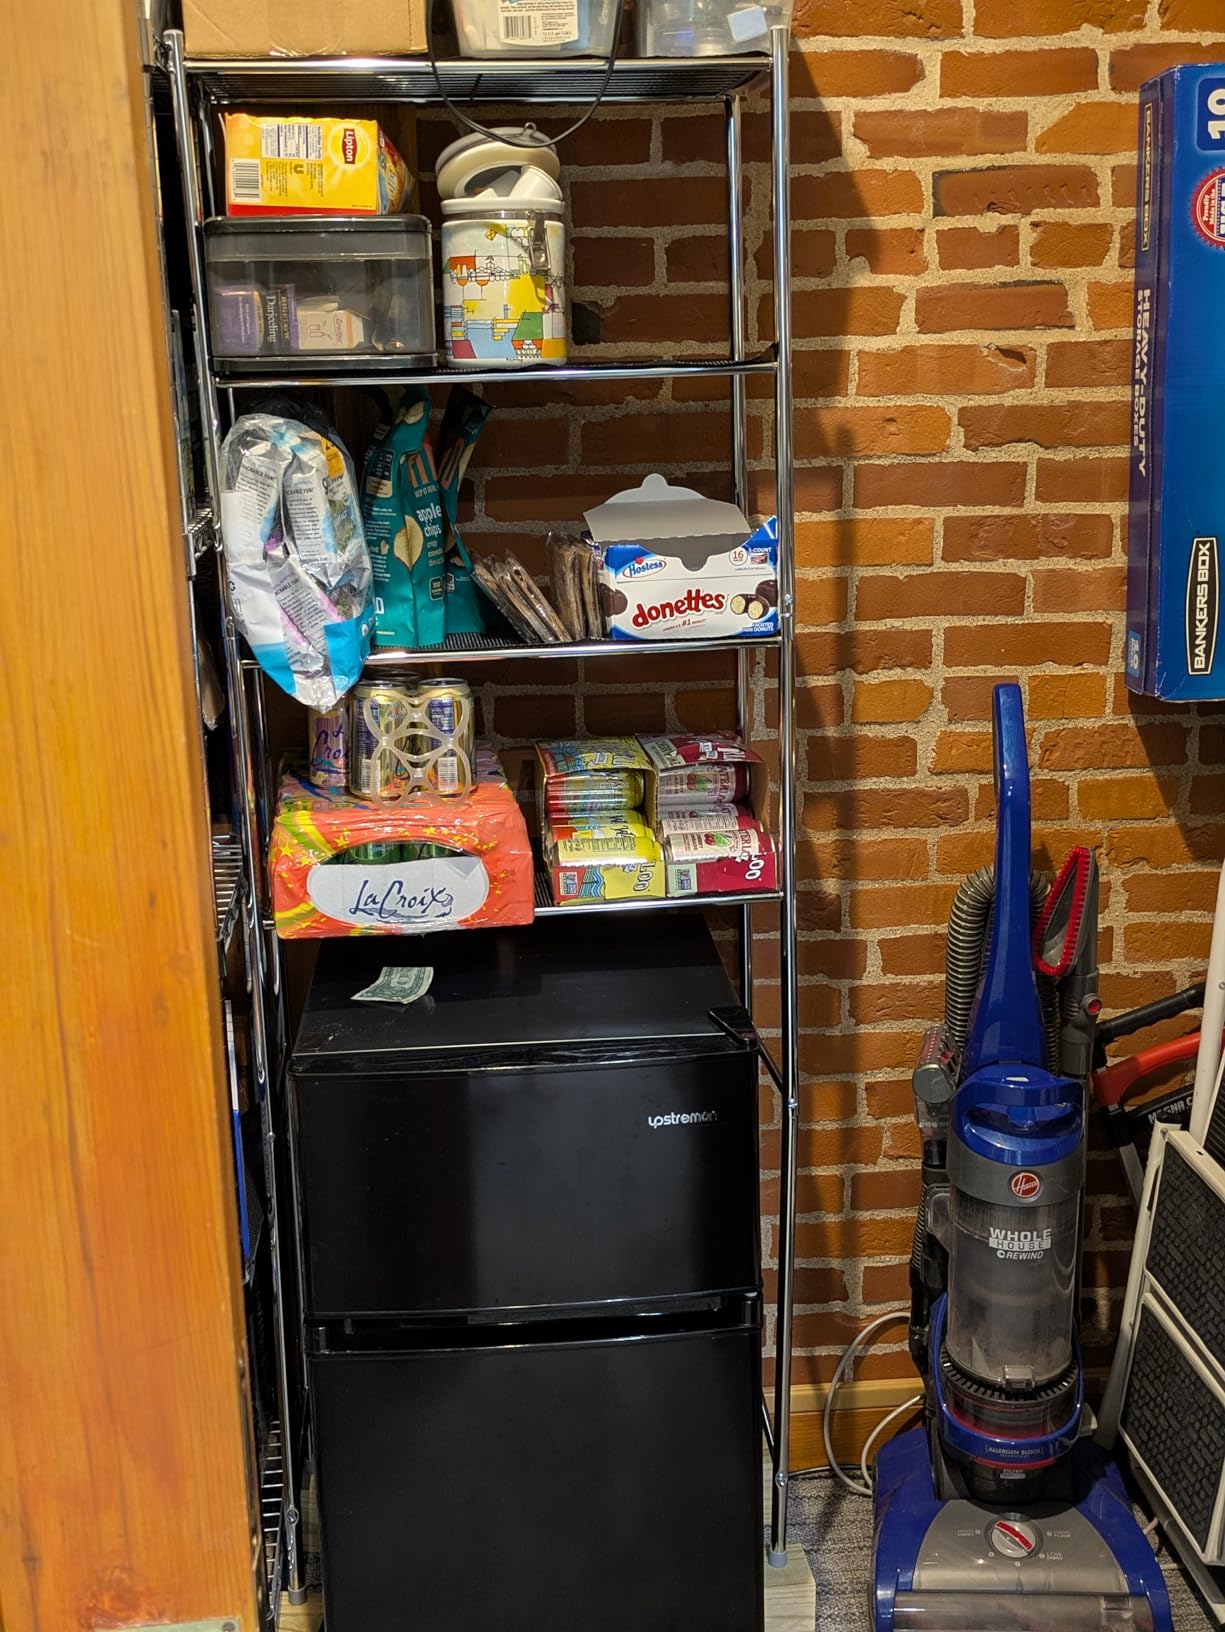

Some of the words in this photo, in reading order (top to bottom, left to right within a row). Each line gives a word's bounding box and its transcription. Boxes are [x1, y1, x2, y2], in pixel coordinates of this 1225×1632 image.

[345, 130, 354, 162] Lipton
[1202, 194, 1210, 221] Proudly
[265, 295, 278, 344] Darjeeling
[280, 296, 289, 341] BIGELOW
[1134, 290, 1143, 381] STORAGE
[1138, 289, 1151, 477] HEAVY-DUTY
[416, 502, 442, 523] apple
[424, 523, 442, 537] chips
[628, 560, 664, 577] Hostess
[1197, 542, 1211, 582] BOX
[632, 588, 726, 628] donettes
[682, 618, 691, 626] #1
[1194, 584, 1208, 669] BANKERS
[349, 880, 450, 919] LaCroix
[989, 1227, 1052, 1242] WHOLE
[996, 1241, 1045, 1250] HOUSE
[1006, 1251, 1044, 1260] REWIND
[988, 1447, 1019, 1455] ALLERGEN
